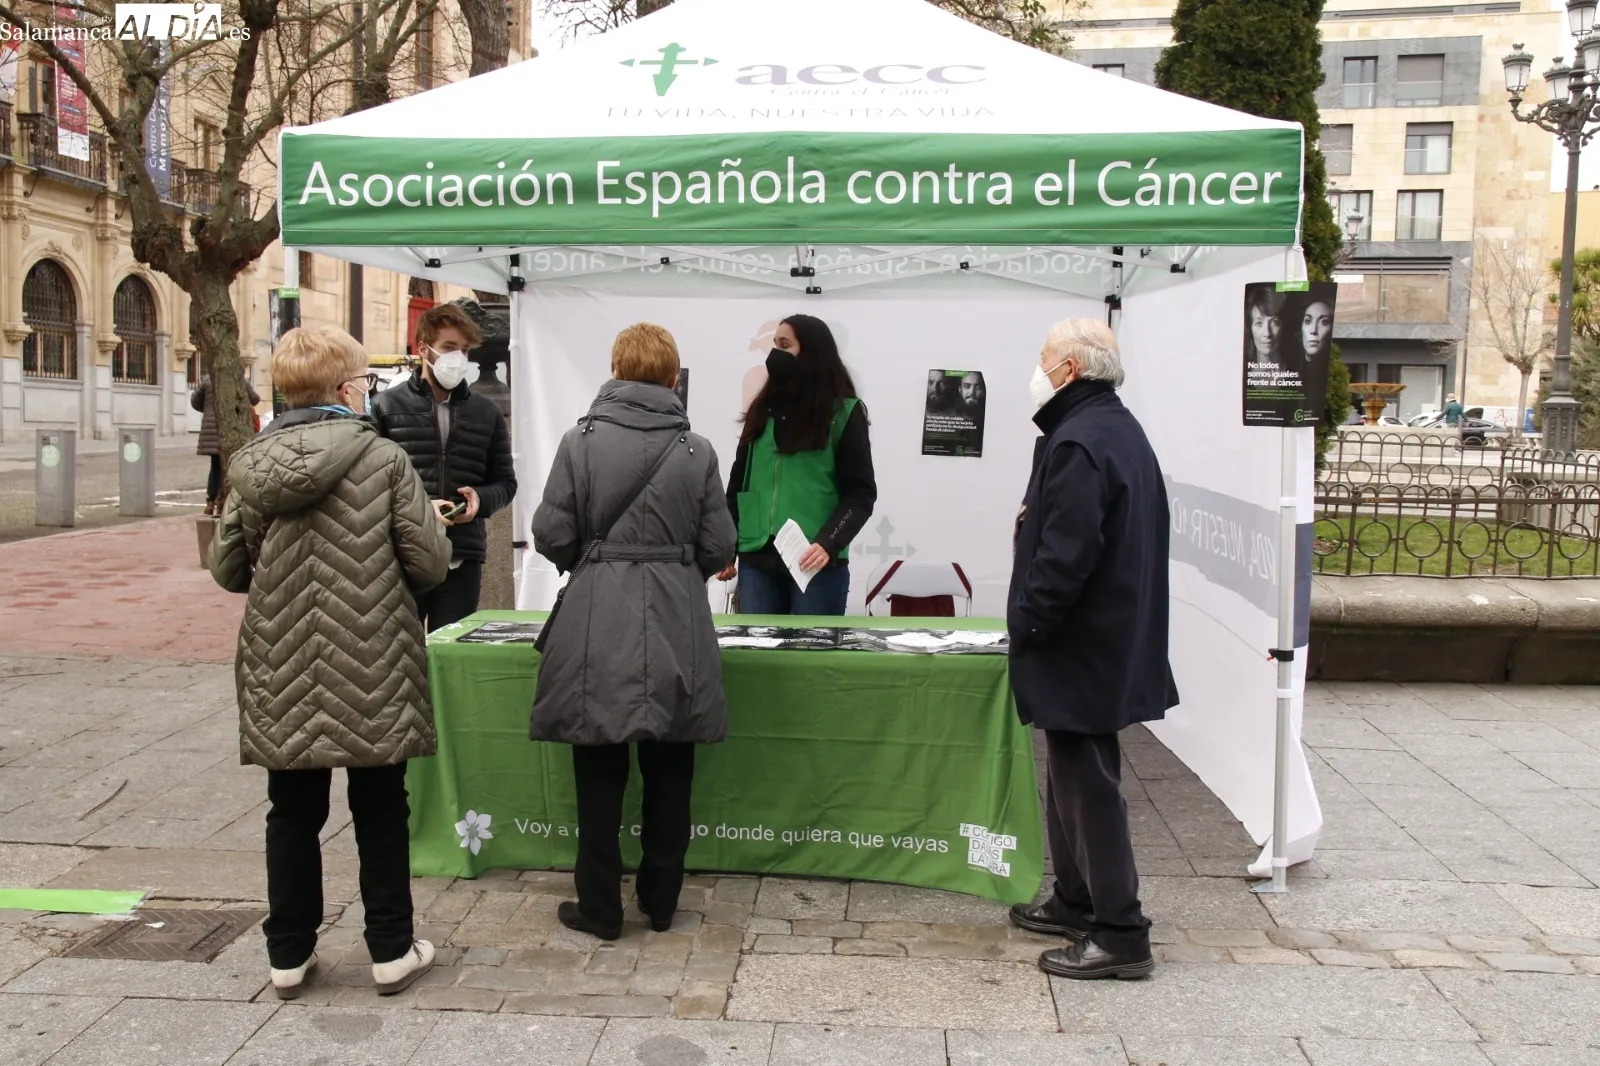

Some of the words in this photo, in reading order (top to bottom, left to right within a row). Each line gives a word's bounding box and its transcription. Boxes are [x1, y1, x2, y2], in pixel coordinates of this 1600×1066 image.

[734, 64, 987, 86] aecc
[607, 107, 642, 118] TU
[750, 107, 909, 119] NUESTRA
[917, 107, 995, 119] VIDA
[299, 159, 574, 207] Asociación
[597, 156, 826, 218] Española
[846, 162, 1013, 206] contra
[1034, 158, 1075, 206] el
[1097, 157, 1283, 207] Cáncer
[1259, 361, 1279, 369] todos
[1271, 370, 1299, 379] iguales
[1246, 378, 1269, 386] frente
[1269, 378, 1277, 386] al
[515, 818, 552, 838] Voy
[558, 825, 569, 837] a
[716, 822, 775, 842] donde
[782, 826, 842, 846] quiera
[848, 831, 885, 849] que
[891, 835, 949, 854] vayas
